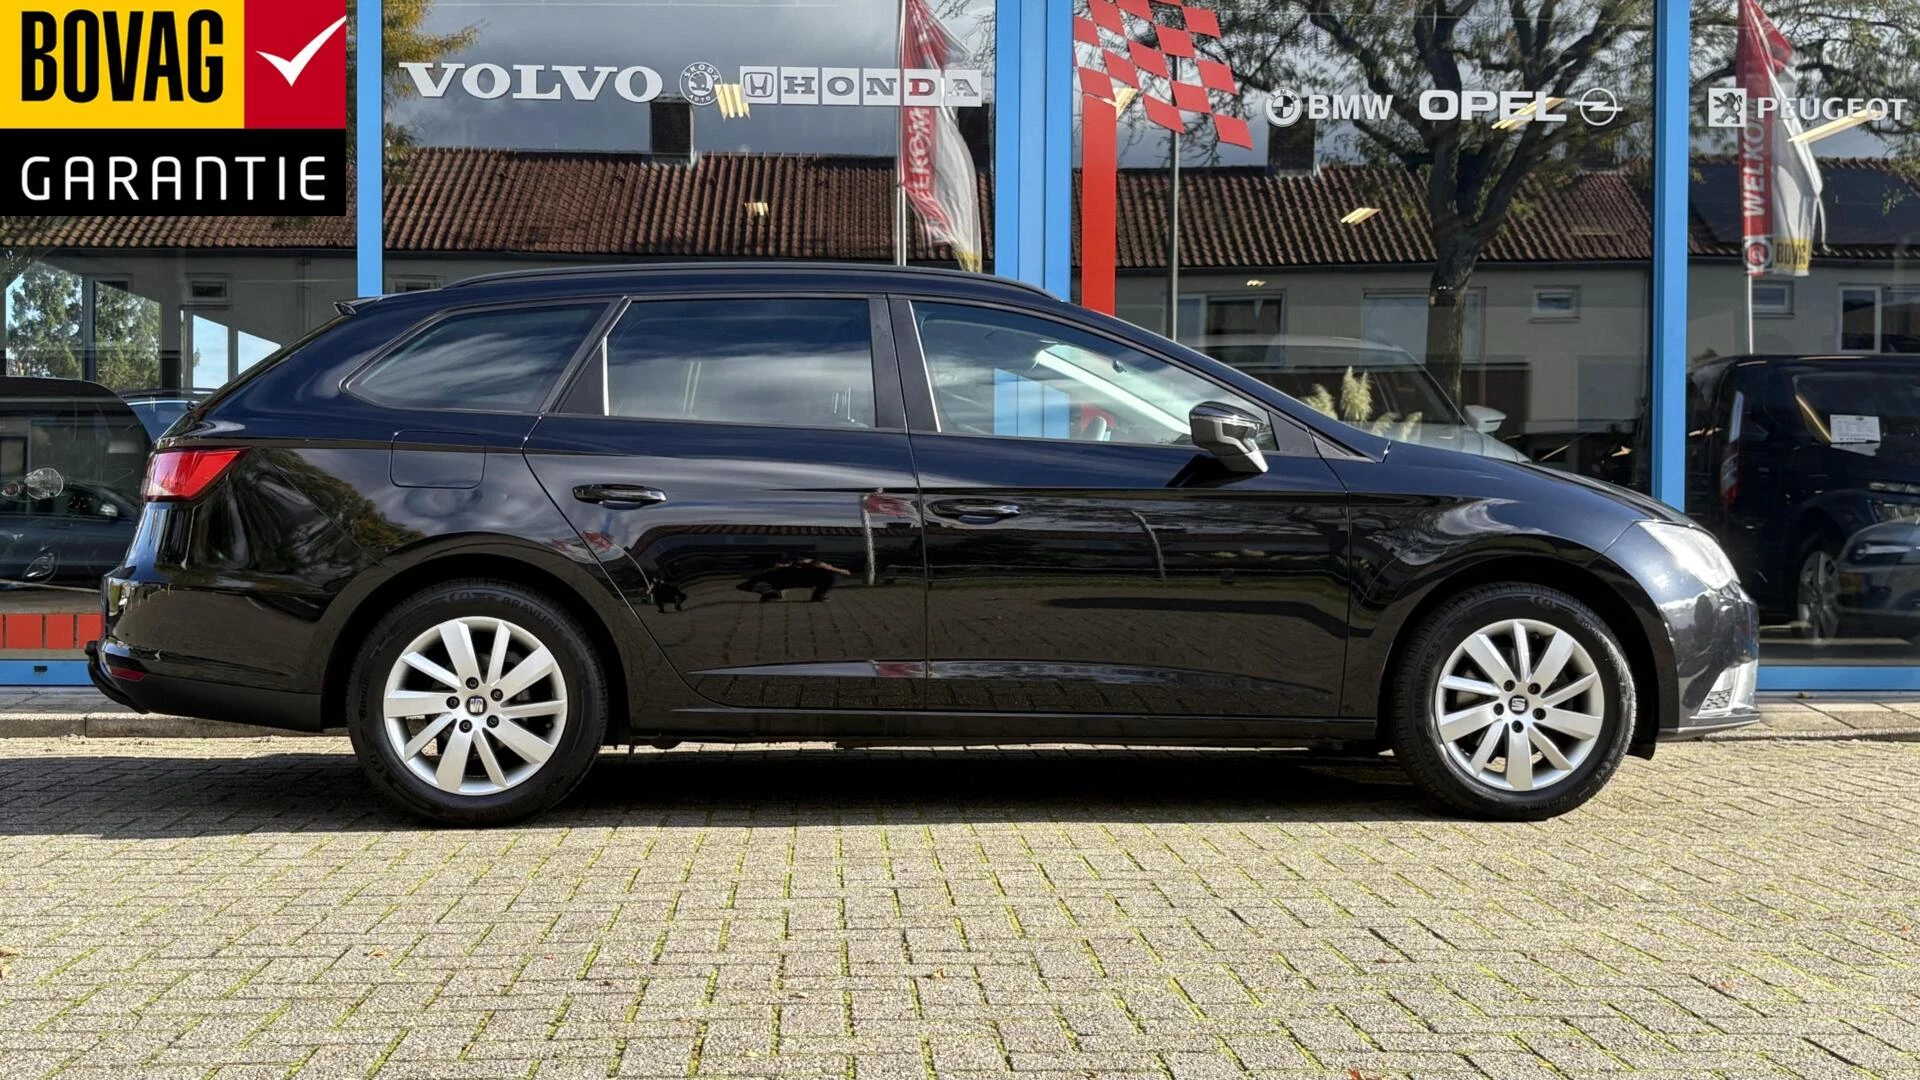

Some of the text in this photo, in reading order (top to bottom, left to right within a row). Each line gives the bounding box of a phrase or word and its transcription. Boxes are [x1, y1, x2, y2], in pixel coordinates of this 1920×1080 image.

[398, 62, 663, 102] VOLVO
[783, 76, 979, 97] HONDA
[1308, 94, 1394, 120] BMW
[1418, 89, 1568, 122] OPEL
[1757, 96, 1908, 121] PEUGEOT
